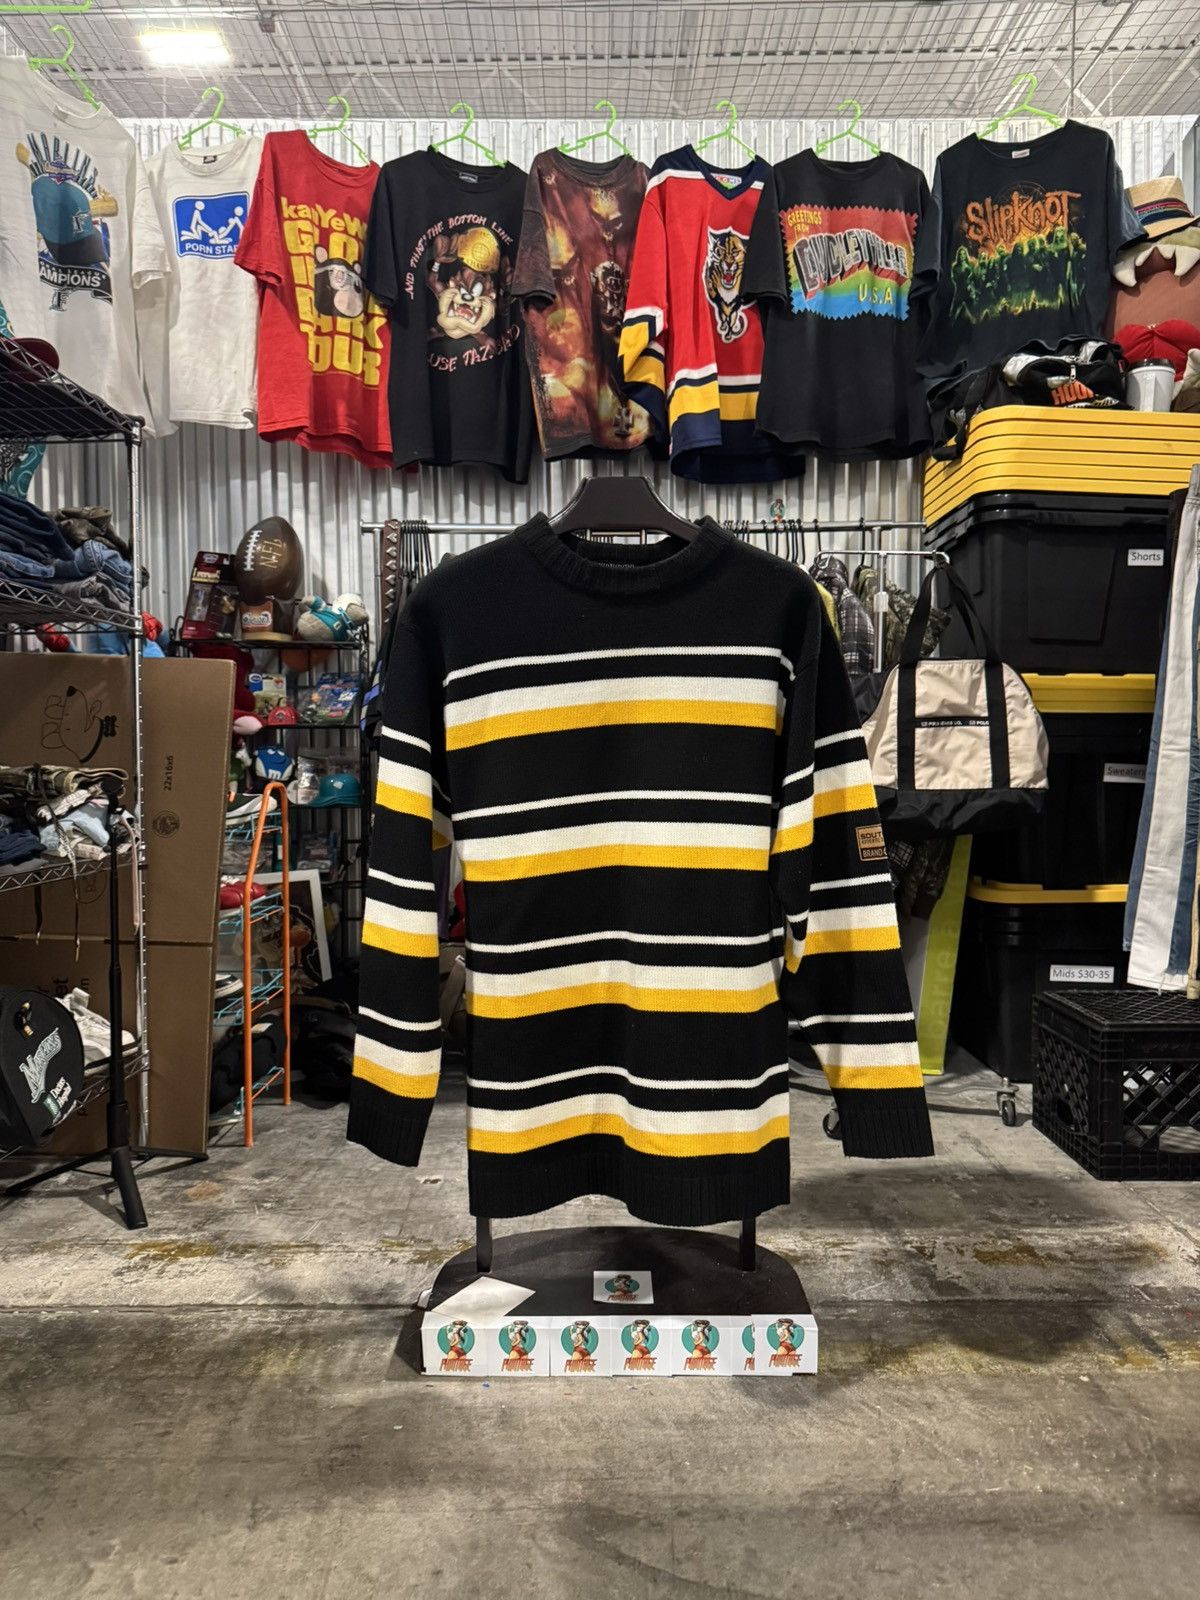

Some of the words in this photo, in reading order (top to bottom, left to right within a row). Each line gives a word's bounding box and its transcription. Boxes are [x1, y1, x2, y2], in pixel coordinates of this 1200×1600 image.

[787, 209, 823, 226] GREETINGS
[426, 221, 444, 239] THE
[447, 214, 487, 229] BOTTOM
[185, 243, 213, 254] PORN
[300, 322, 383, 386] TOUR
[1130, 551, 1161, 561] Shorts
[162, 754, 175, 792] 22x16x6
[1052, 968, 1075, 979] Mids
[1077, 969, 1110, 980] $30-35
